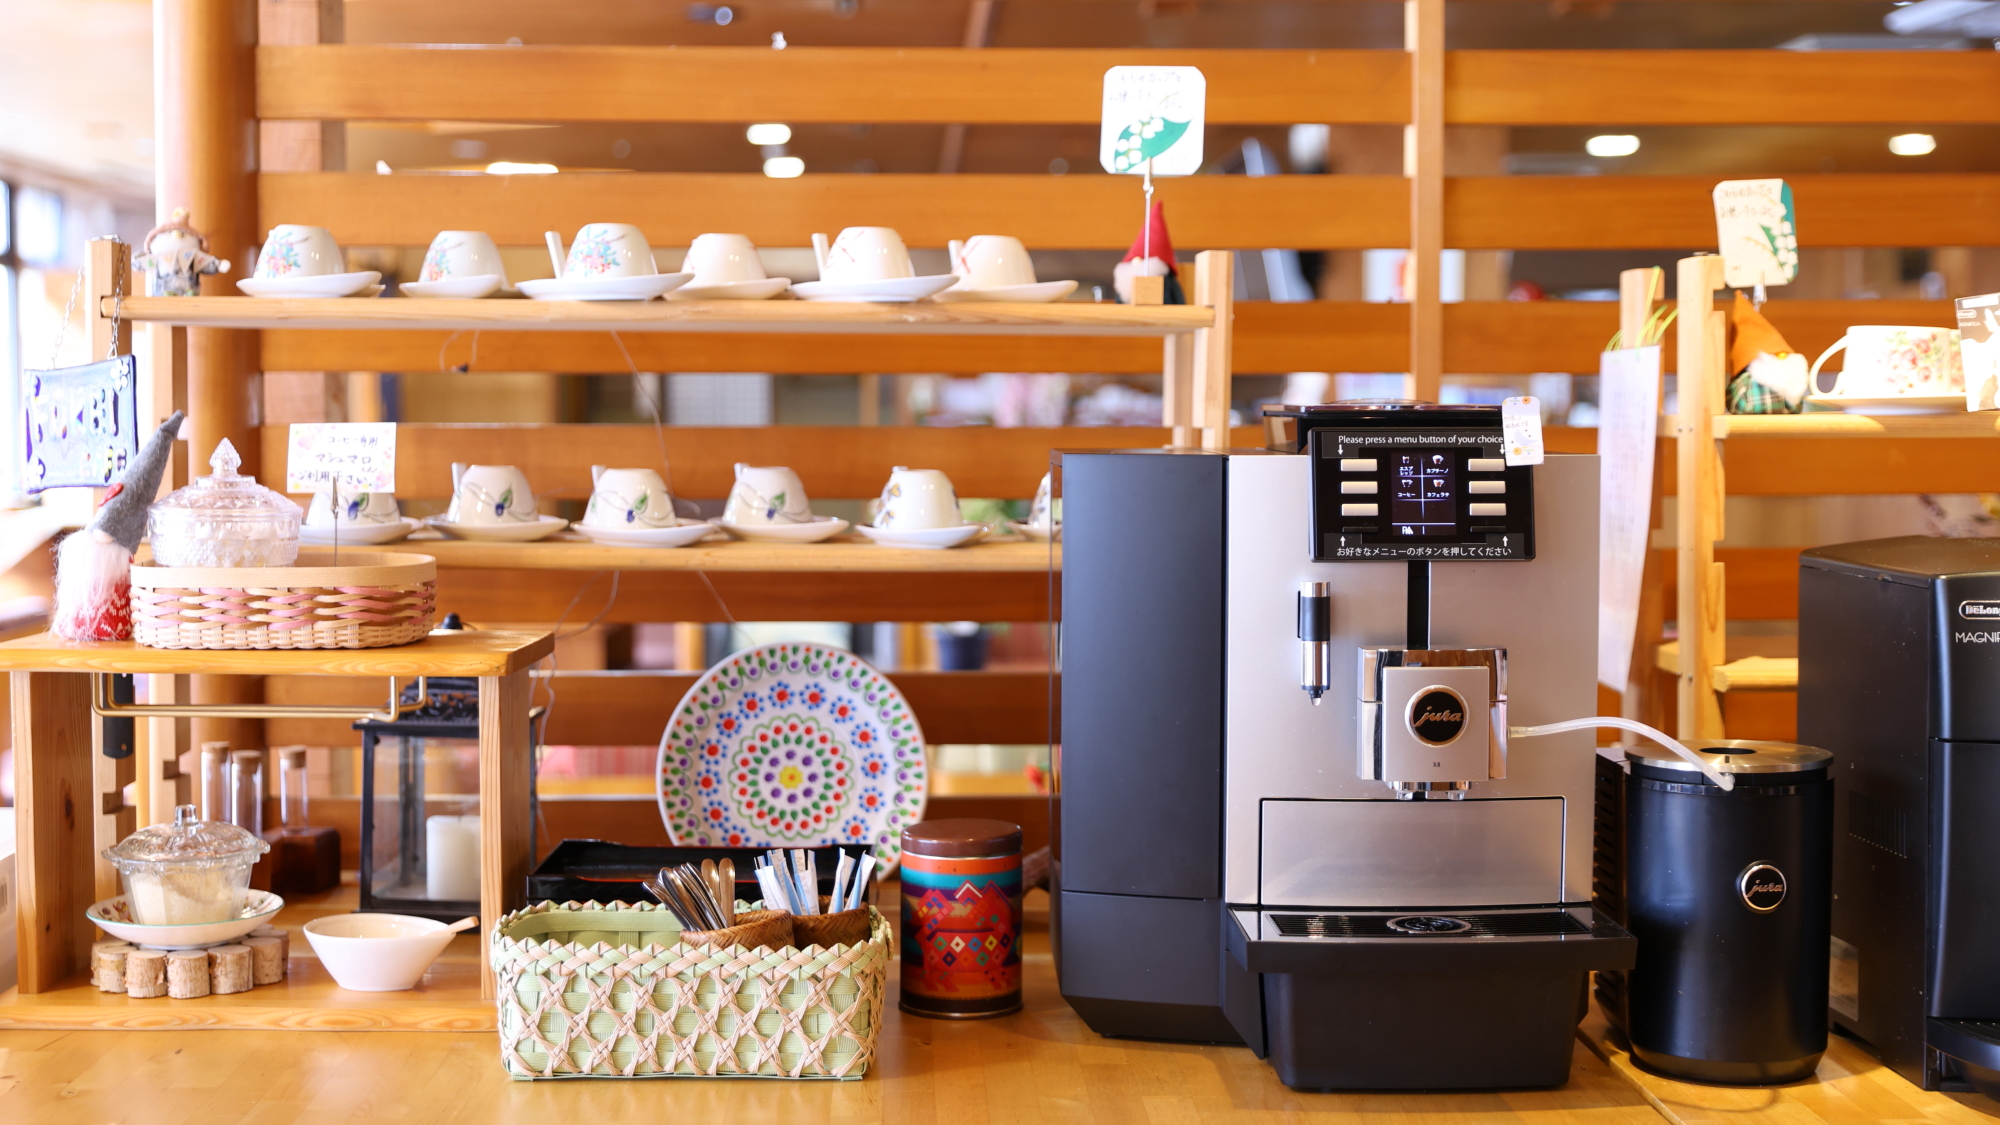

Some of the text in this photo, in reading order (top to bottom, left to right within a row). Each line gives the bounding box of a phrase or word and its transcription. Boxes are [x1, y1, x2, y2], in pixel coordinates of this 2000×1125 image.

[1338, 435, 1503, 445] Please press a menu button of your choice
[1336, 546, 1512, 557] お好きなメニューのボタンを押してください
[1413, 705, 1462, 727] jura
[1746, 879, 1784, 898] jura
